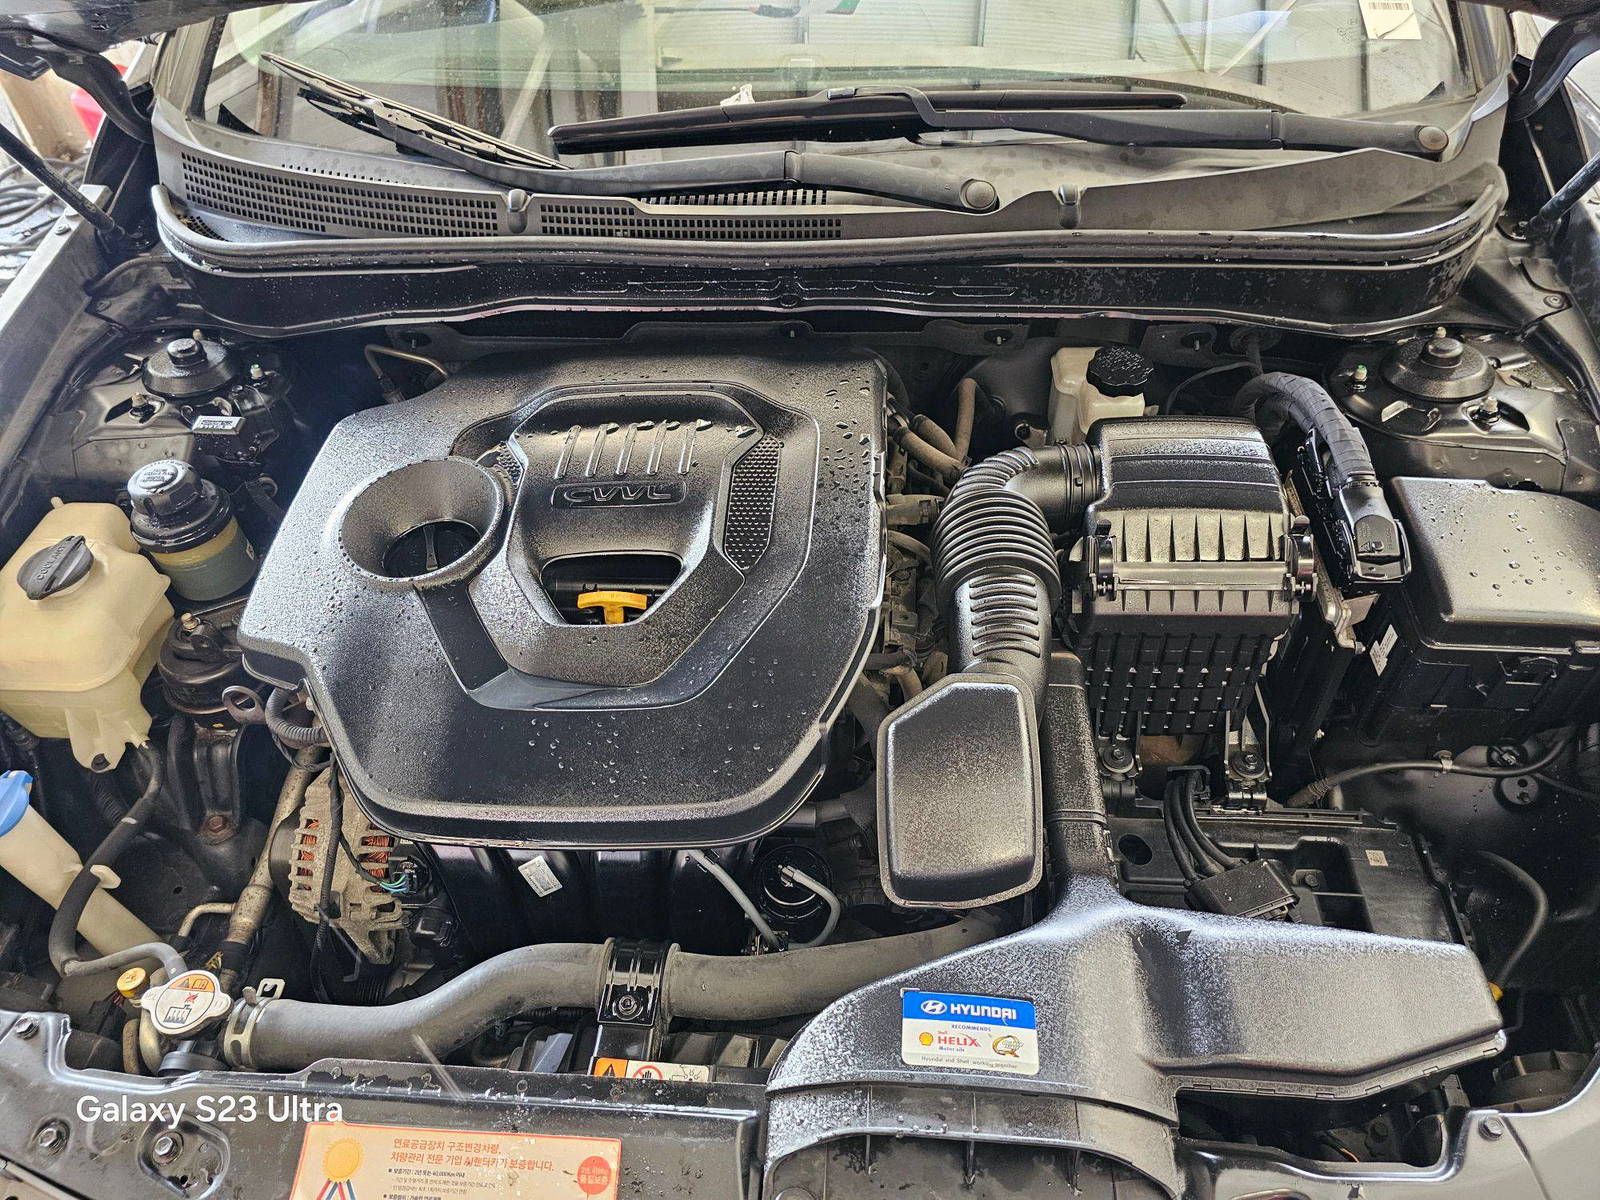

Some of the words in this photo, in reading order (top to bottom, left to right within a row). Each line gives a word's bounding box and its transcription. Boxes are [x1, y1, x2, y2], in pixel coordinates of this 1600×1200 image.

[563, 485, 672, 502] CVVL
[950, 1003, 1017, 1020] HYUNDAI
[951, 1024, 992, 1032] RECOMMENDS
[937, 1034, 981, 1048] HELIX
[921, 1055, 944, 1063] Hyundai
[393, 1138, 445, 1151] 연료공급장치
[390, 1151, 425, 1163] 차량관리
[427, 1153, 444, 1165] 전문
[445, 1155, 462, 1166] 기업
